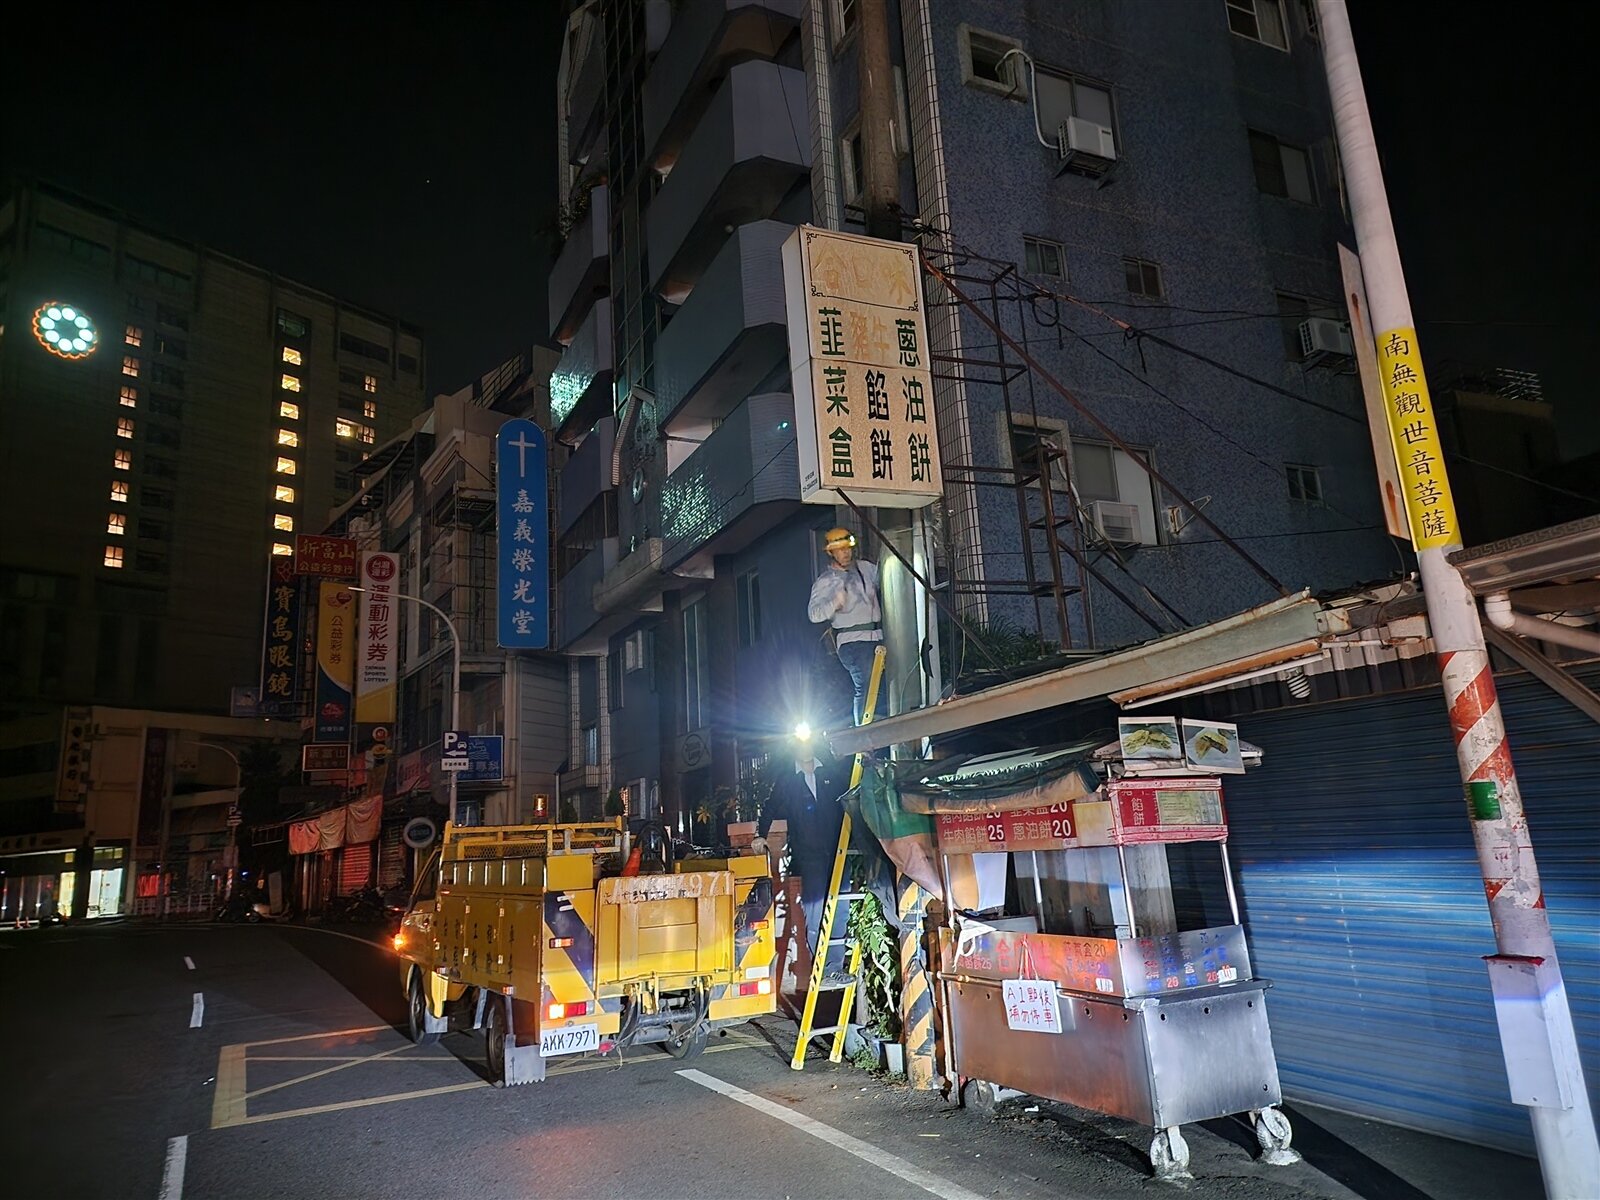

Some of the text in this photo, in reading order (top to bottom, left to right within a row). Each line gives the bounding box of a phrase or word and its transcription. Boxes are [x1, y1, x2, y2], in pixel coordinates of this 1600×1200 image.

[865, 369, 894, 481] 餡餅
[895, 318, 932, 483] 蔥油餅
[1384, 333, 1451, 539] 南無觀世音菩薩
[300, 538, 355, 560] 新富山
[511, 488, 536, 635] 嘉義榮光堂
[267, 585, 295, 697] 寶島眼鏡
[329, 615, 344, 665] 公益彩券
[367, 584, 390, 662] 運動彩券
[444, 732, 458, 750] P
[943, 824, 1005, 844] 牛肉餡餅 25
[1052, 819, 1072, 837] 20
